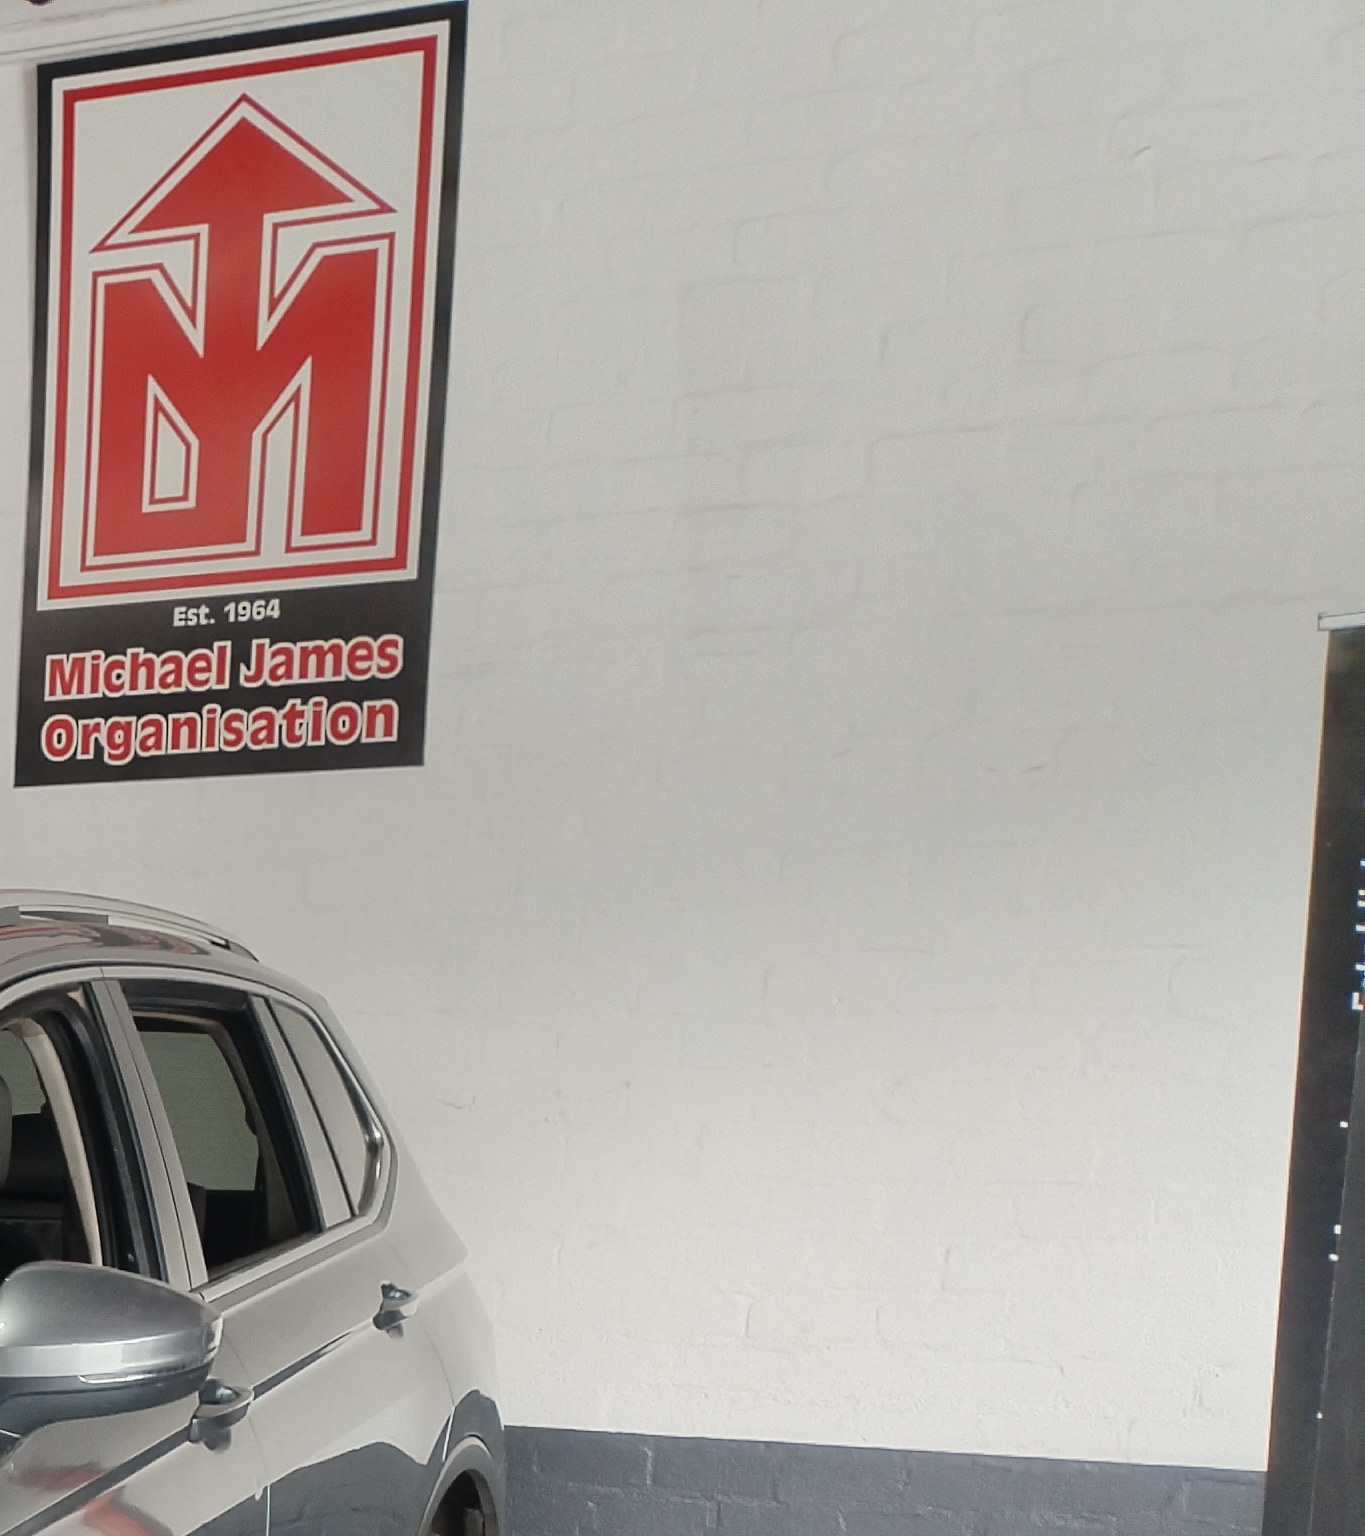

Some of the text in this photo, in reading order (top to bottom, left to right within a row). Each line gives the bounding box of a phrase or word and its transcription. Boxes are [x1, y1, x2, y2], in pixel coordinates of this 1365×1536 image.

[173, 598, 281, 628] Est. 1964
[44, 634, 405, 701] Michael James
[41, 696, 400, 765] Organisation
